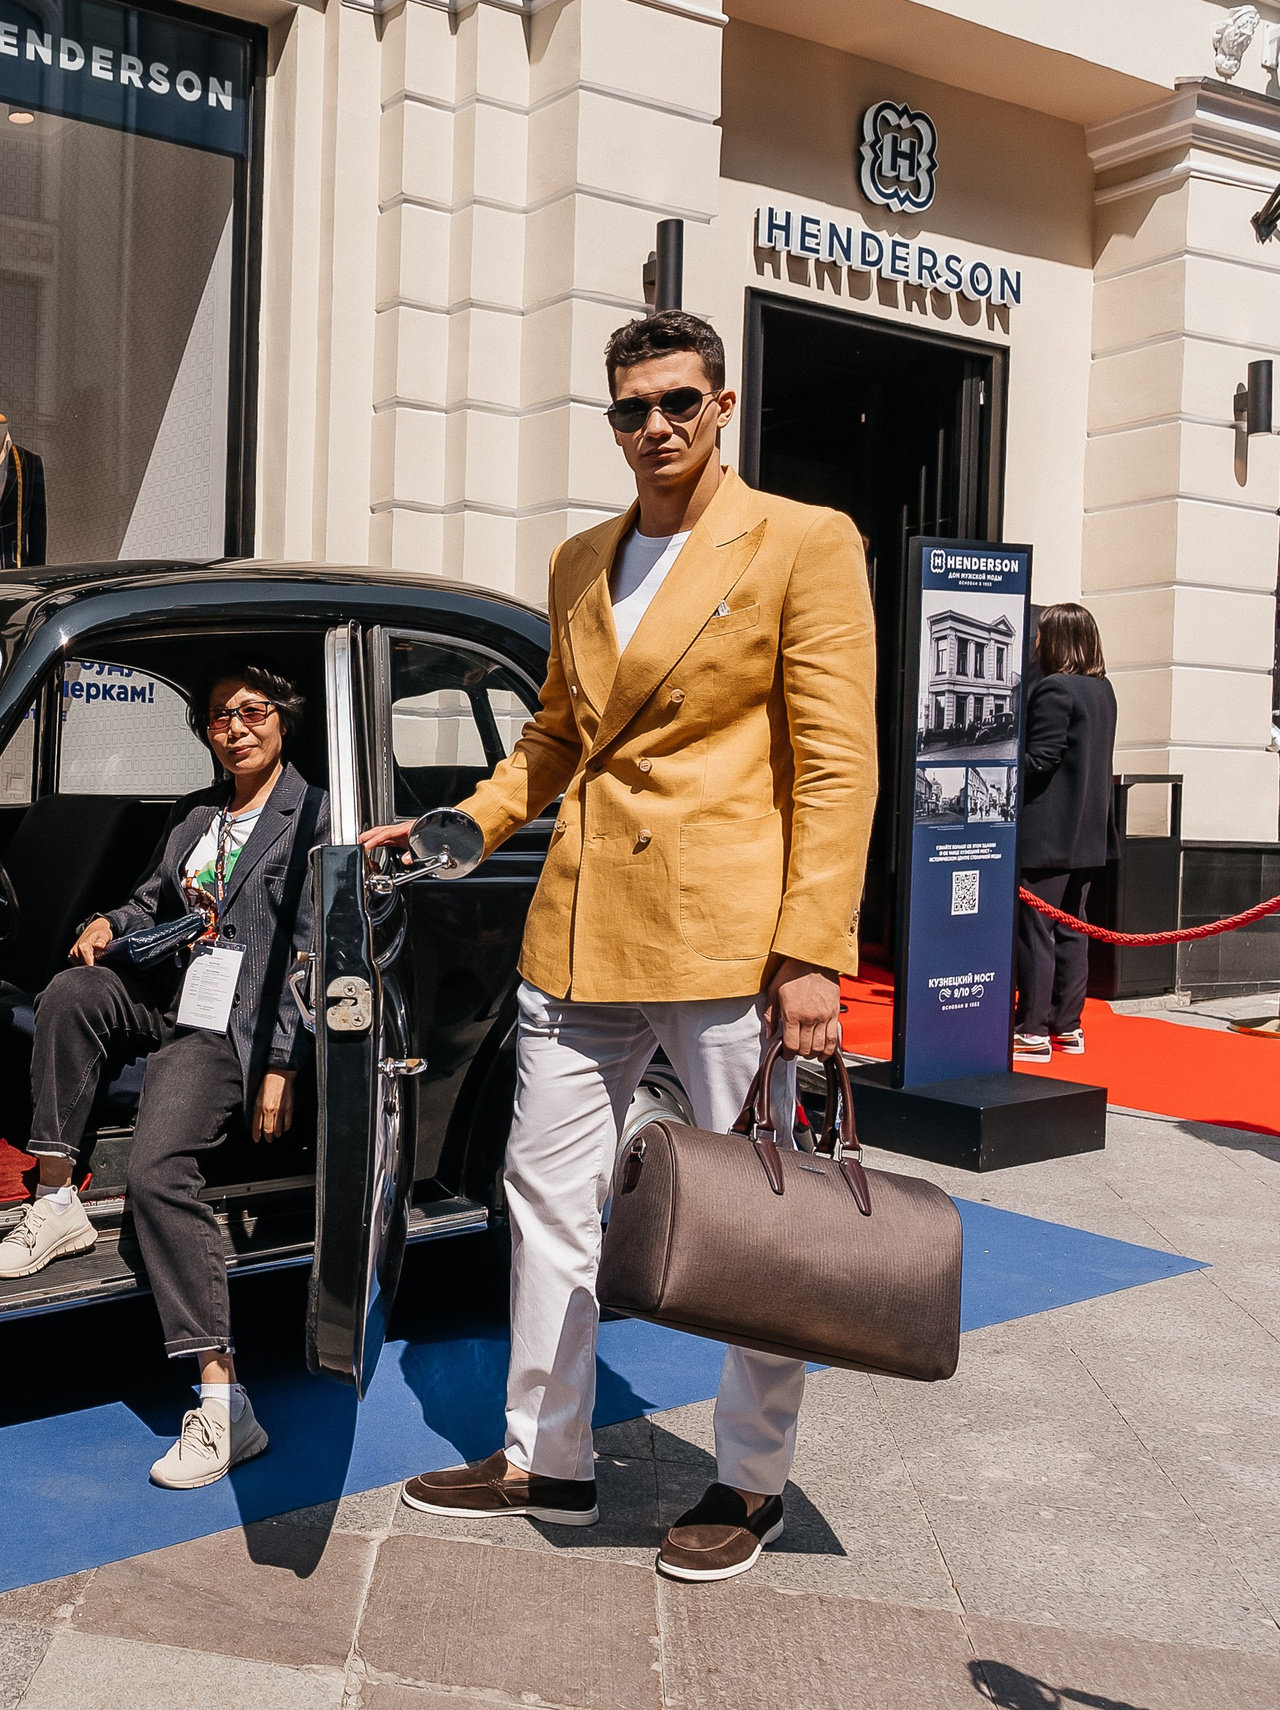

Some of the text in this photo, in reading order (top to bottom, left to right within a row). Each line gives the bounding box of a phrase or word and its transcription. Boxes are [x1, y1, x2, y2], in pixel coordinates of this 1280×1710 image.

[760, 206, 1021, 307] HENDERSON
[947, 556, 1019, 573] HENDERSON
[928, 972, 995, 988] КУЗНЕЦКИЙ МОСТ
[953, 987, 970, 998] 9/10
